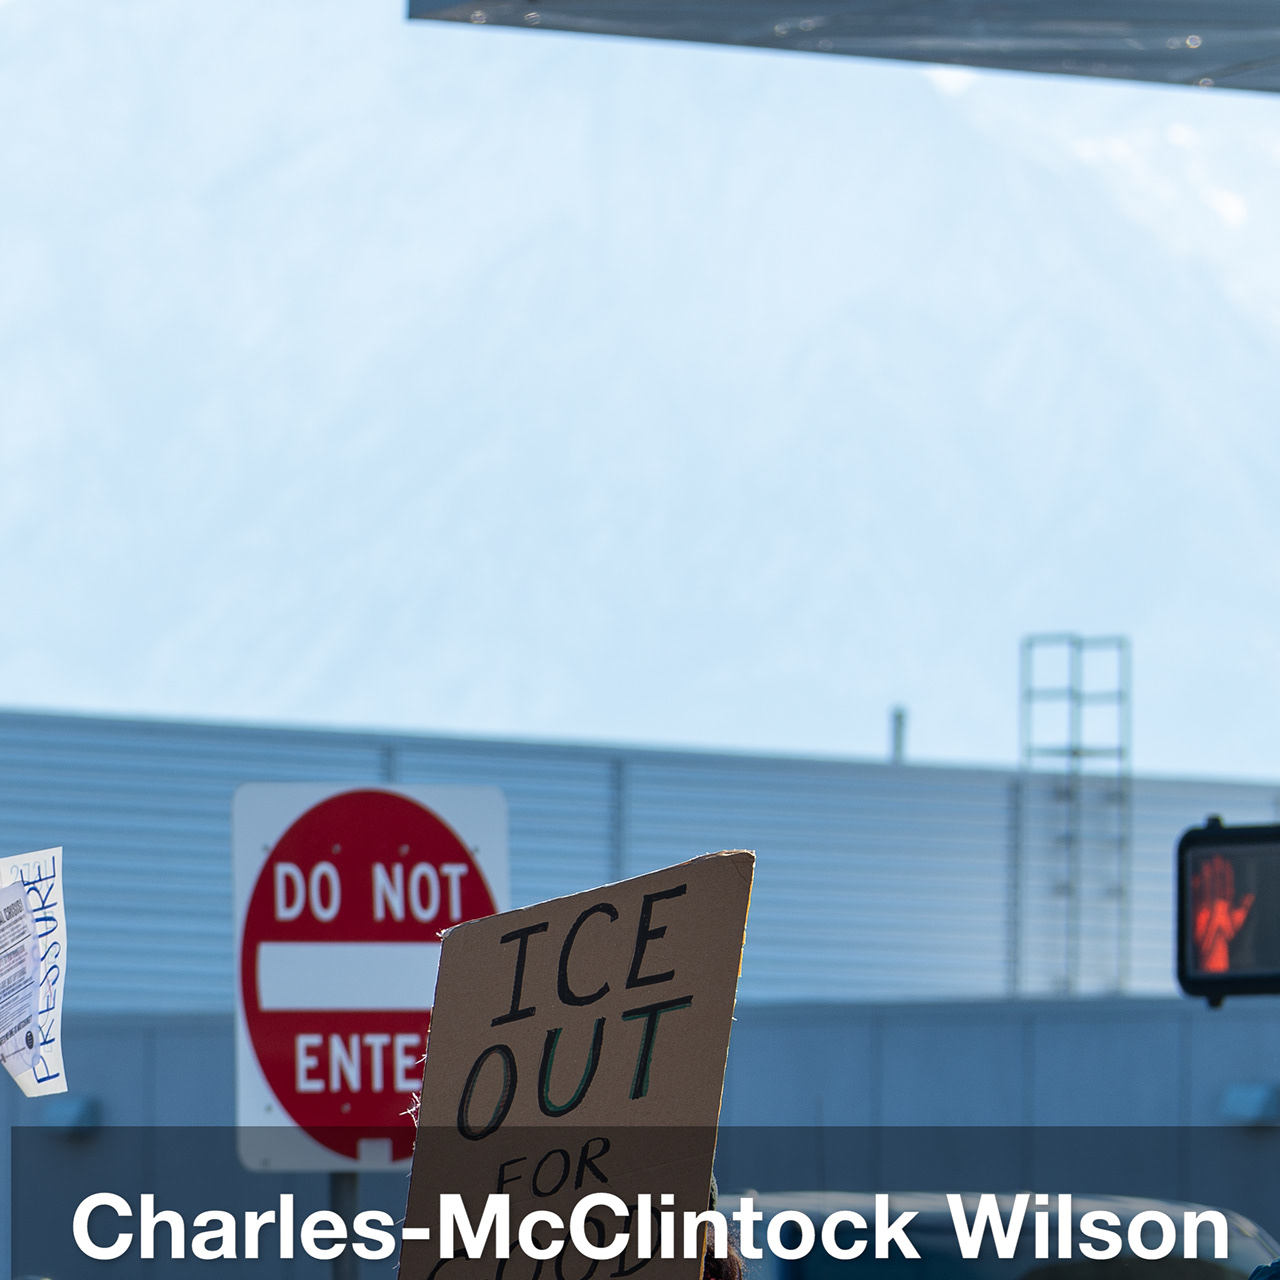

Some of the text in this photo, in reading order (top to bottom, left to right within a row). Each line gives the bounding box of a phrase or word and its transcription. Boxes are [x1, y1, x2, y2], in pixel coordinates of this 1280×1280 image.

[274, 860, 468, 922] DO NOT
[20, 855, 61, 1084] PRESSURE
[490, 884, 688, 1027] ICE
[295, 1033, 422, 1094] ENTE
[457, 994, 694, 1141] OUT
[495, 1137, 611, 1198] FOR
